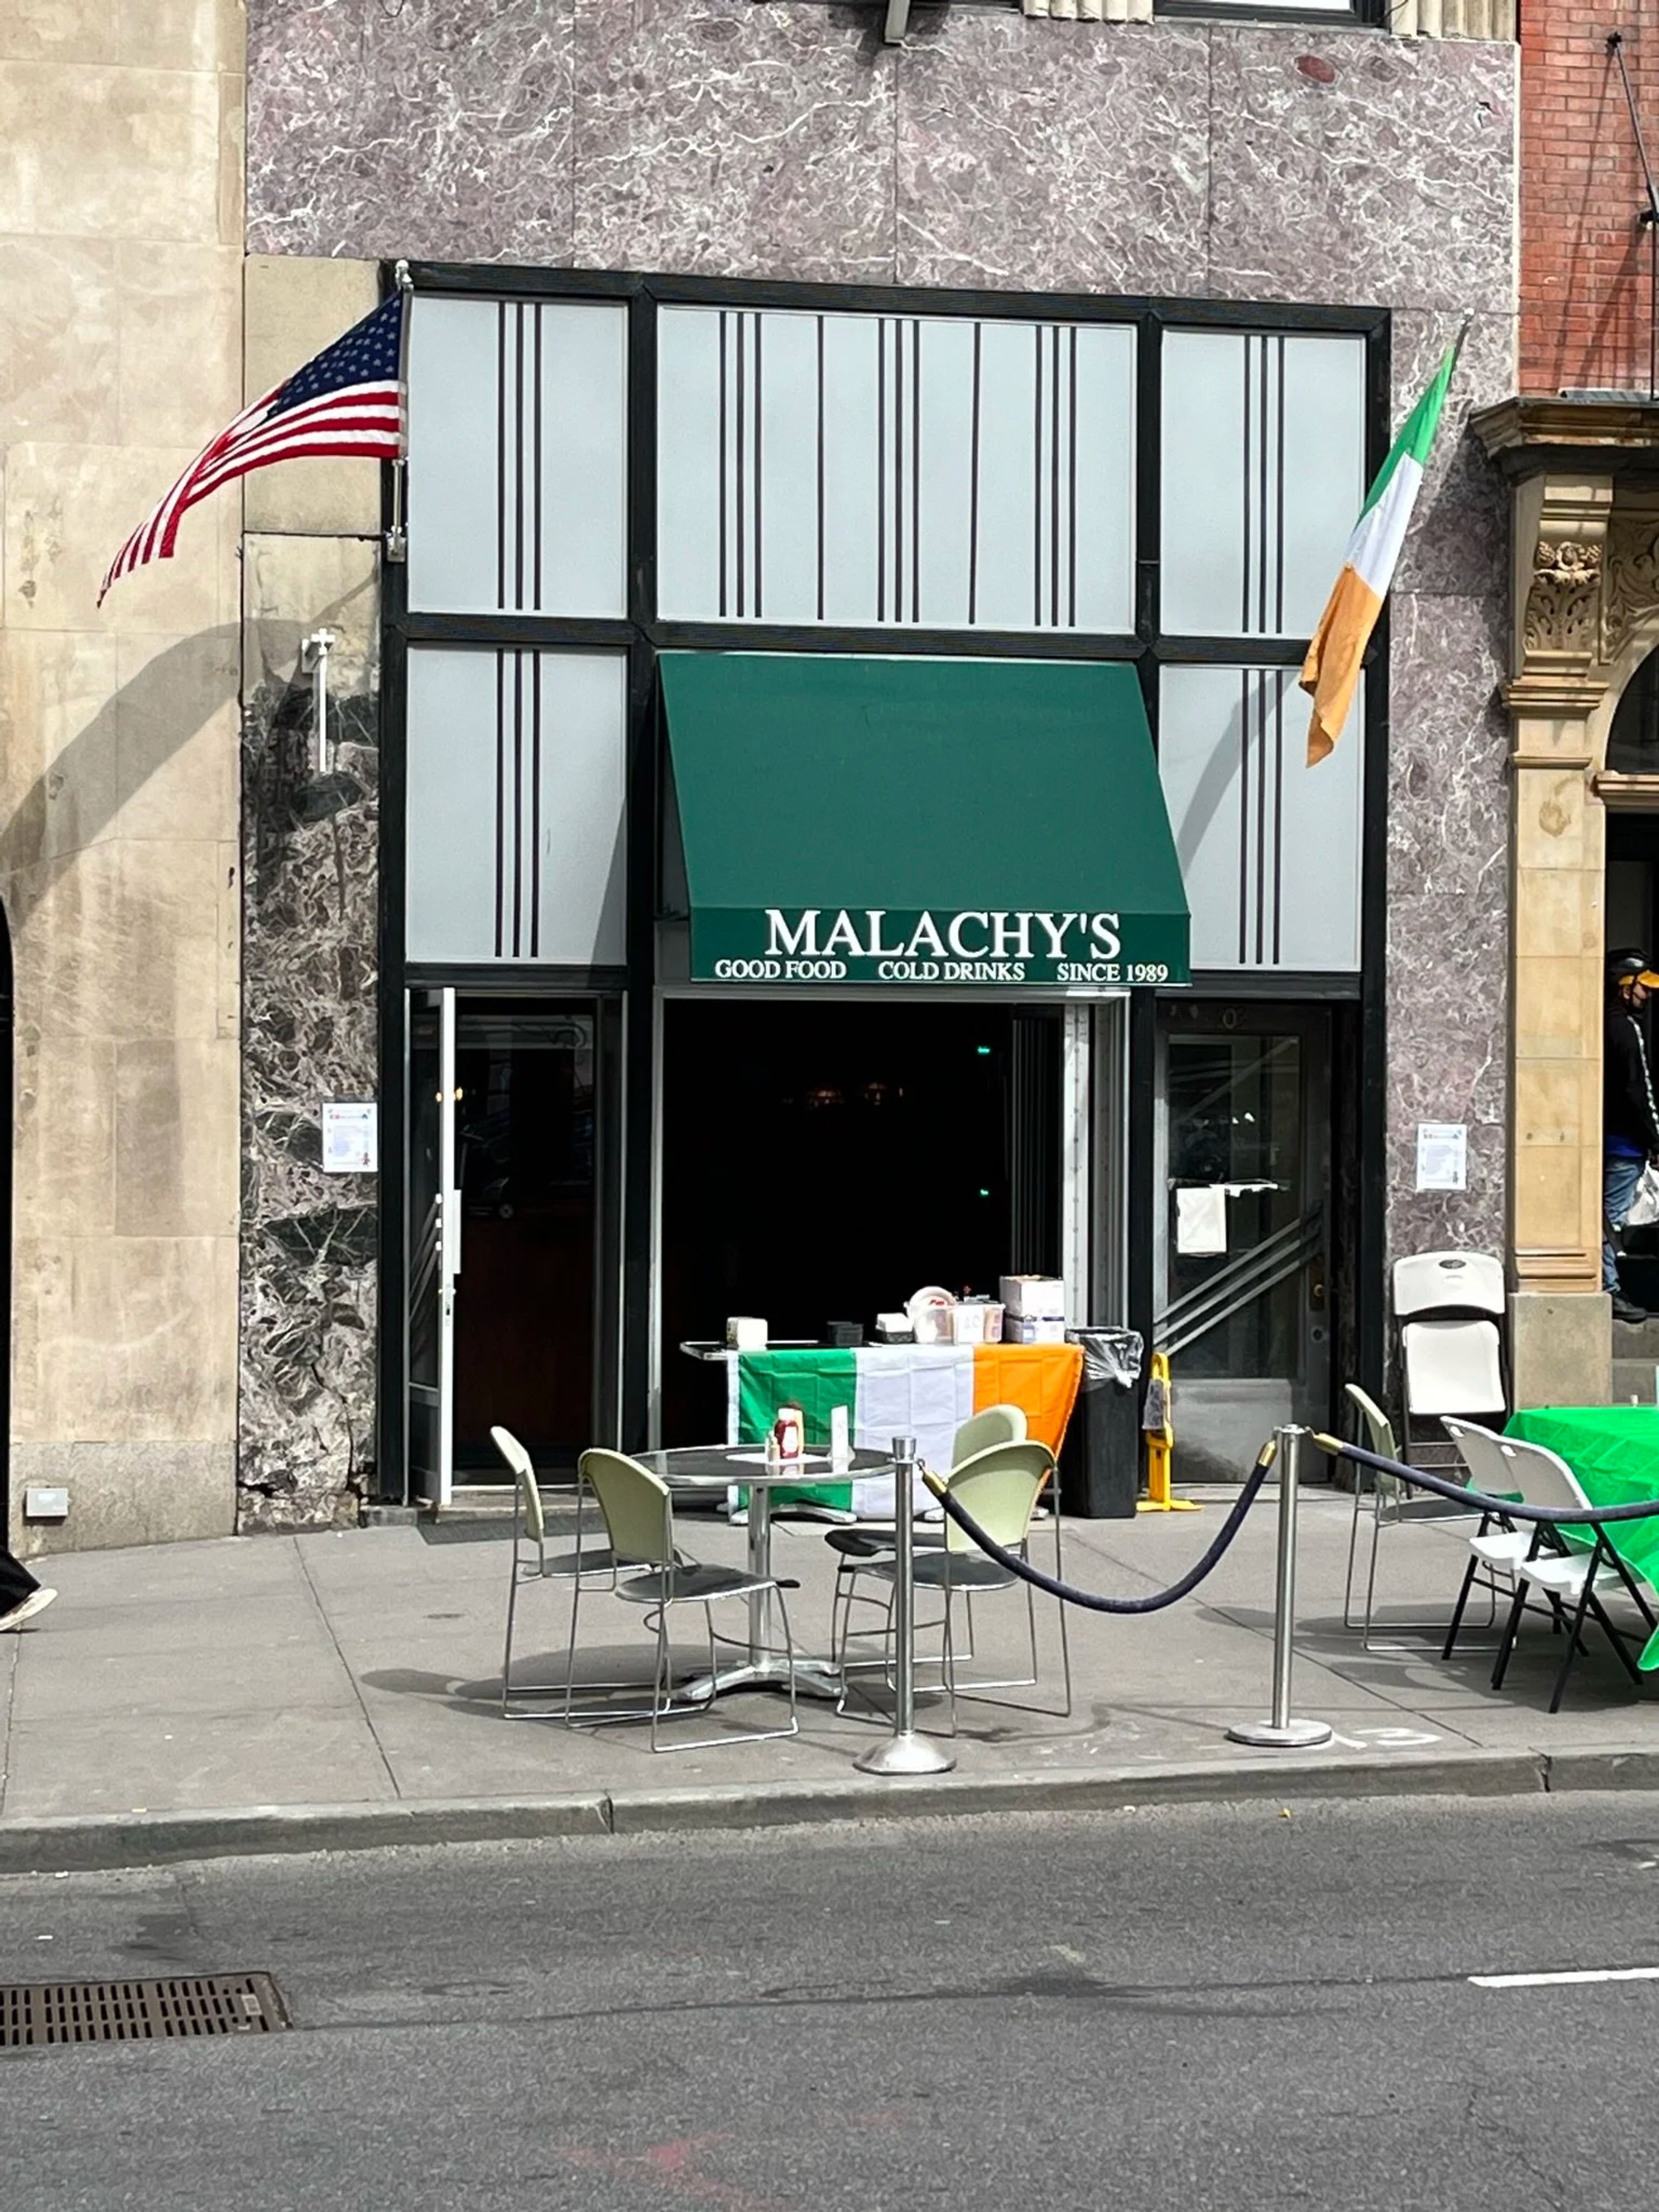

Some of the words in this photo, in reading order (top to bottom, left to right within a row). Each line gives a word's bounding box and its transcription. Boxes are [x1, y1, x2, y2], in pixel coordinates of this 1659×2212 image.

[764, 909, 1121, 959] MALACHY'S
[715, 959, 781, 980] GOOD
[785, 960, 847, 981] FOOD
[877, 960, 943, 982] COLD
[944, 961, 1025, 983] DRINKS
[1057, 962, 1121, 983] SINCE
[1126, 963, 1169, 982] 1989
